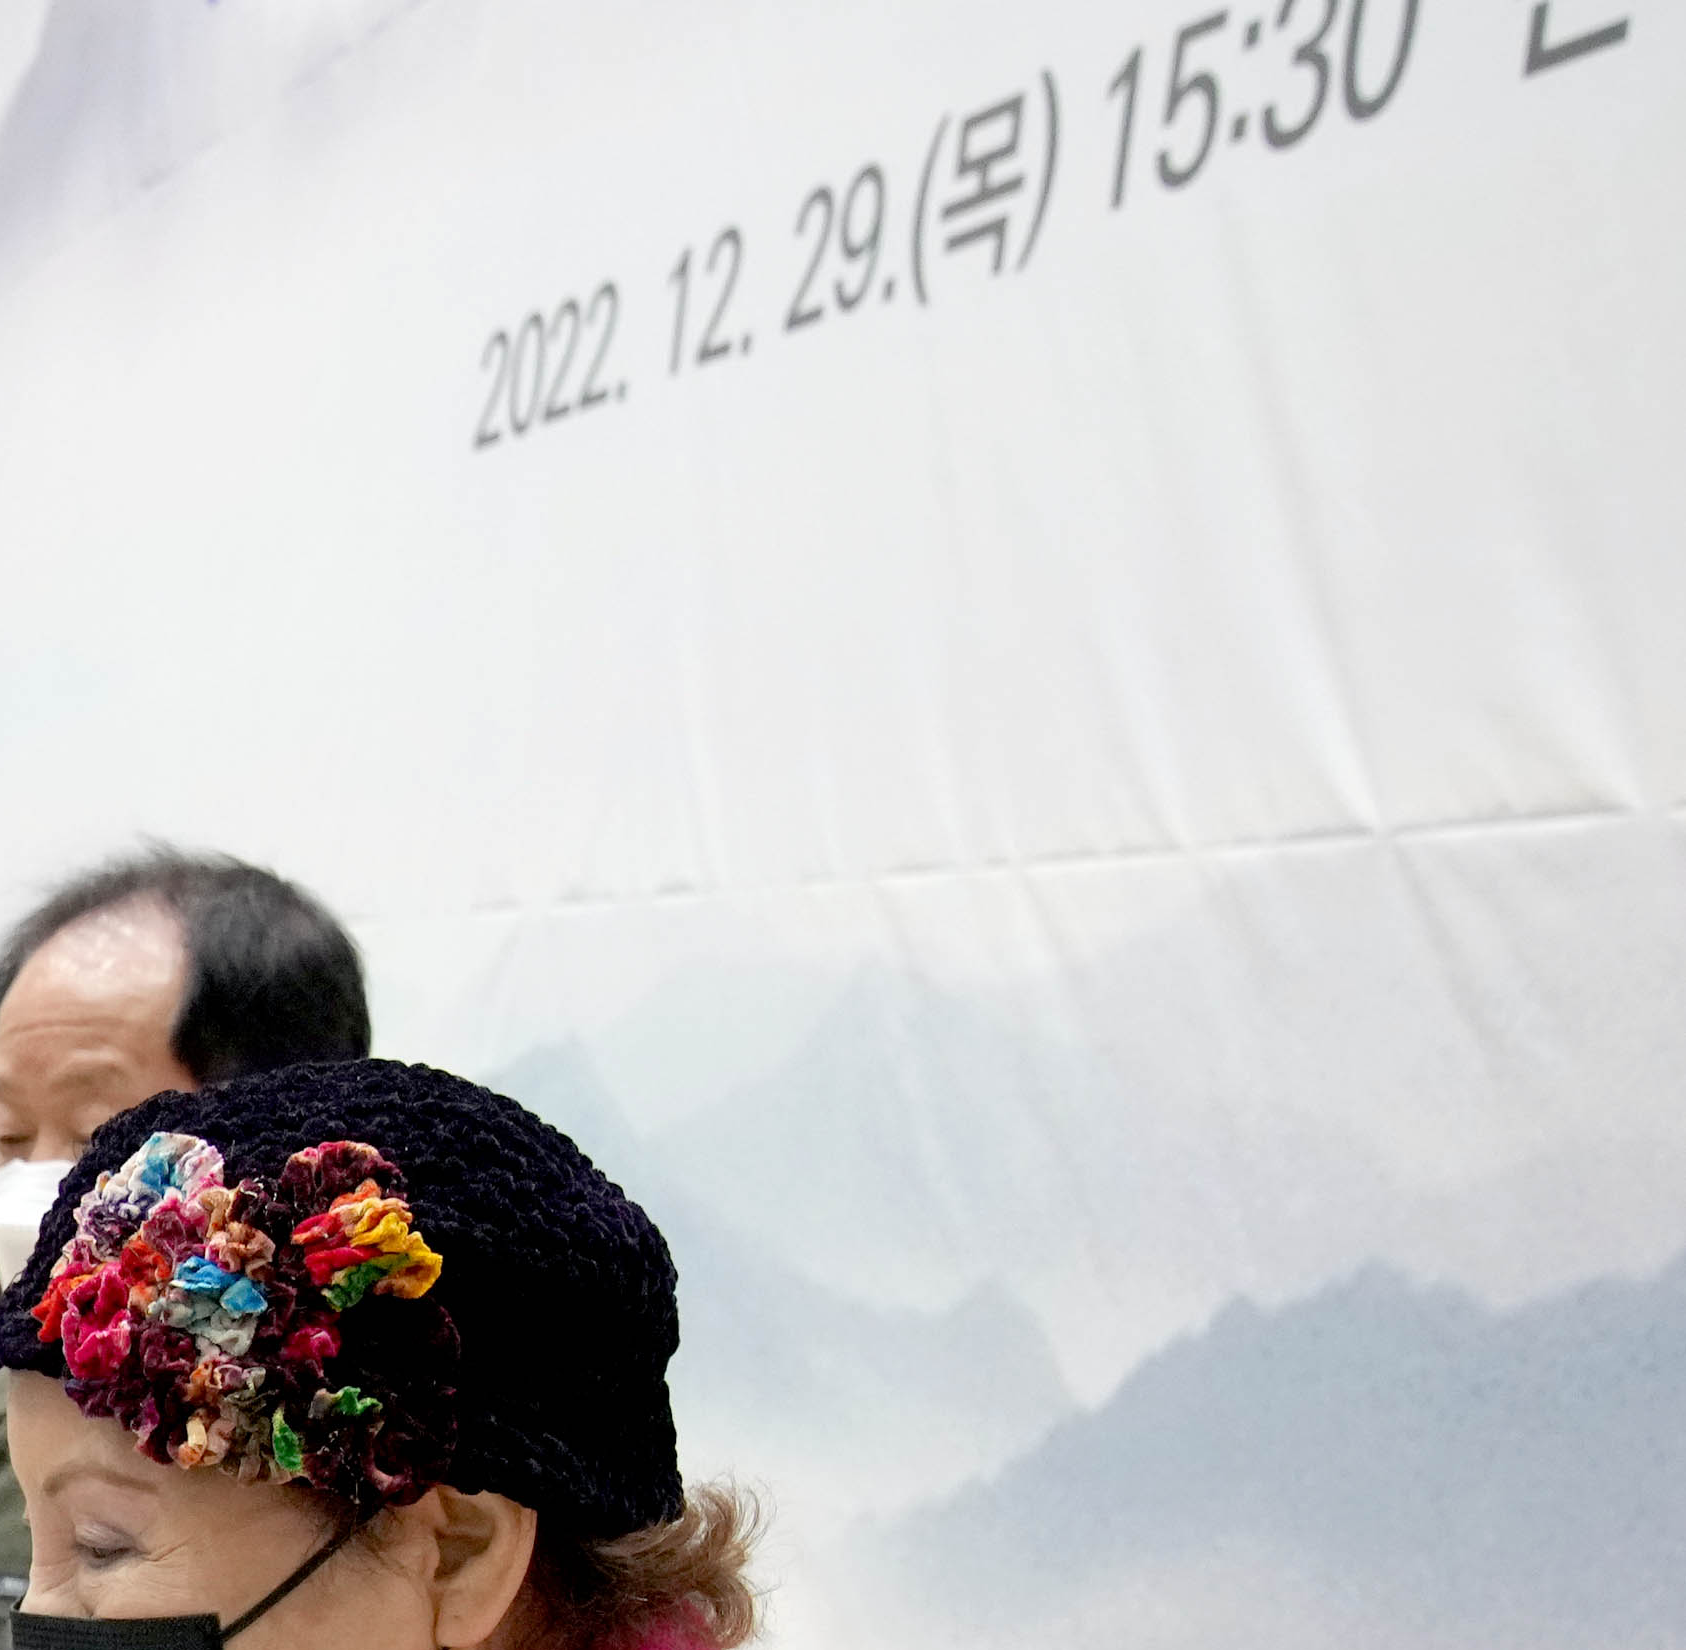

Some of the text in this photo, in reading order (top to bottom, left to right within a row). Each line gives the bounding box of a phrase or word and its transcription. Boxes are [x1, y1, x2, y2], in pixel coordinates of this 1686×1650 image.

[473, 280, 629, 451] 2022.
[668, 224, 752, 376] 12.
[1106, 0, 1421, 210] 15:30
